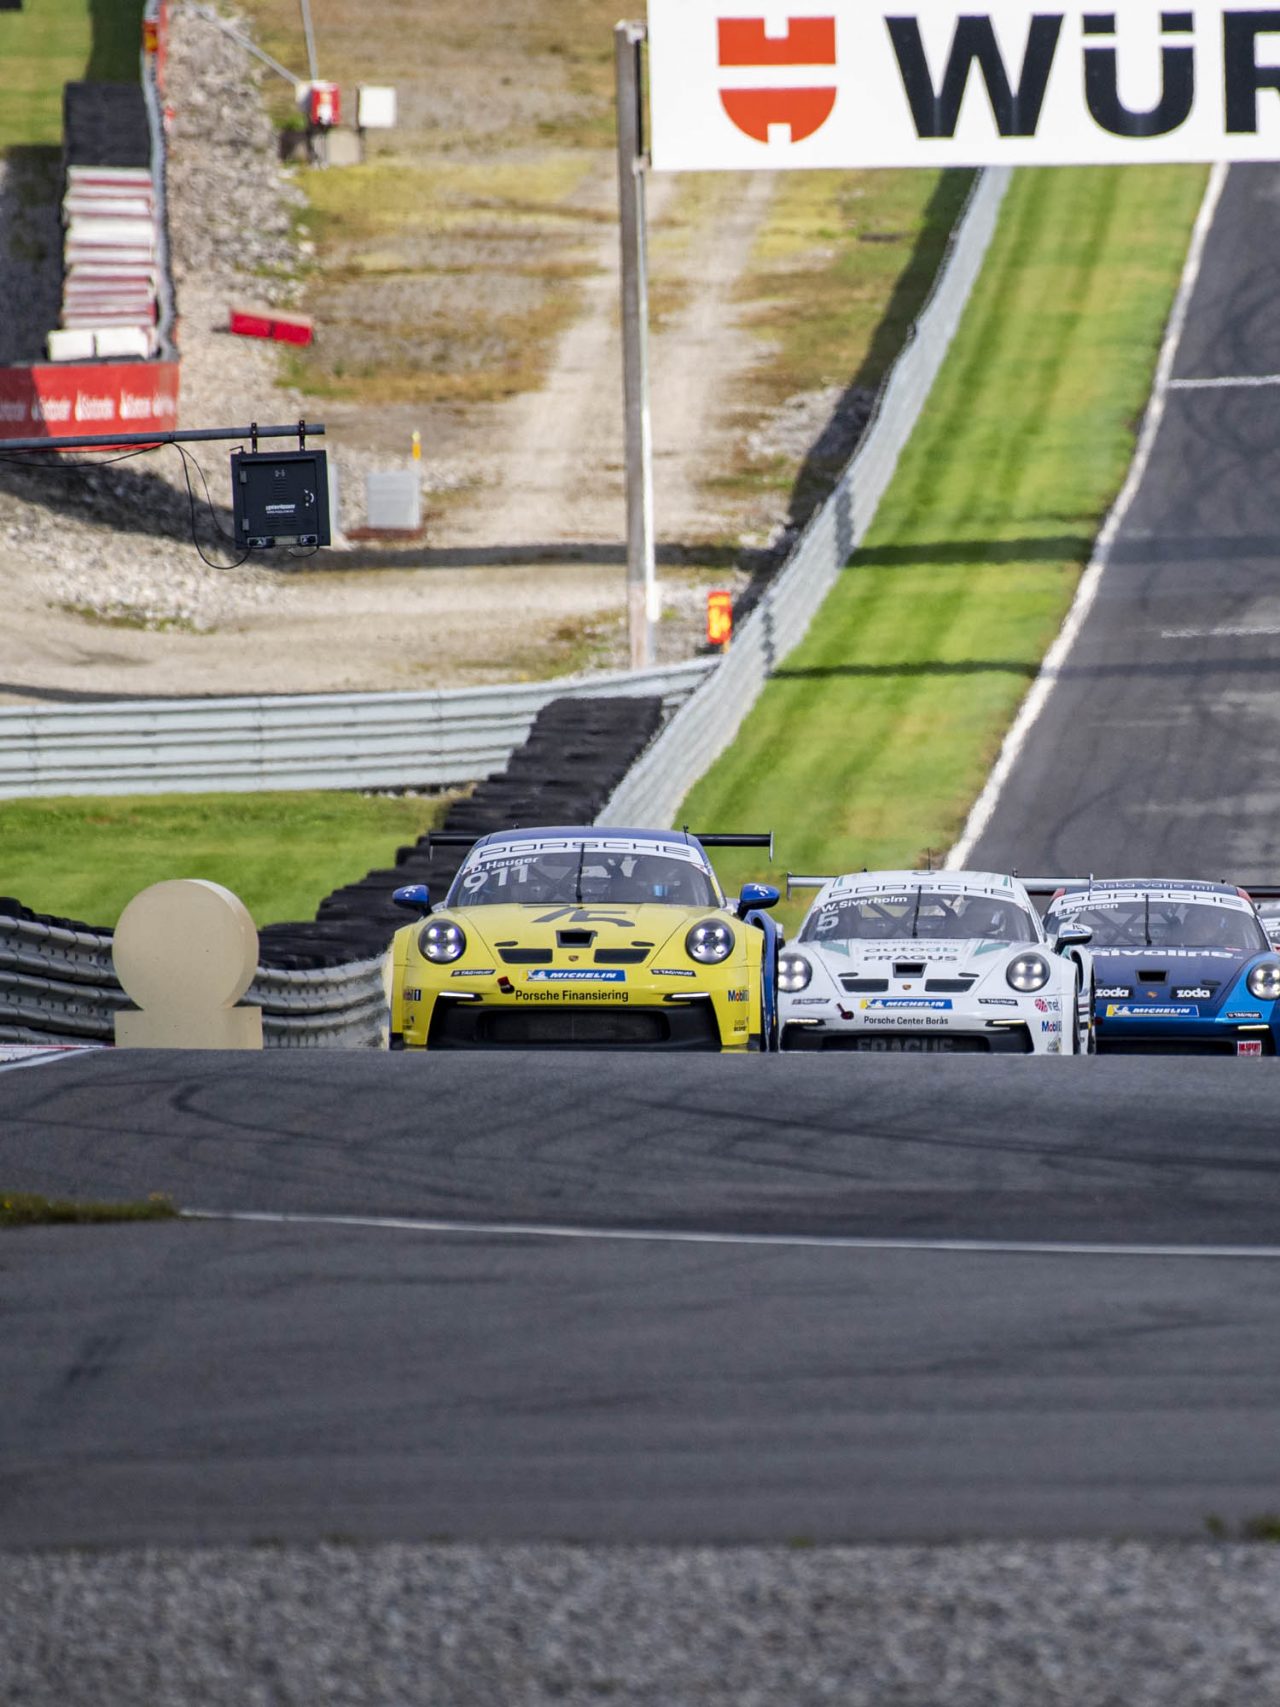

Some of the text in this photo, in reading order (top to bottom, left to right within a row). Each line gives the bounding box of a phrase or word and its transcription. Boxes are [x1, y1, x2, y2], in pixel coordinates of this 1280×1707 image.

[478, 841, 692, 859] PORSCHE
[471, 856, 540, 873] D.Hauger
[463, 864, 529, 894] 911
[828, 883, 1016, 899] PORSCHE
[1061, 891, 1243, 907] PORSCHE
[820, 895, 908, 914] W.Siverholm
[1055, 902, 1119, 918] E.Persson
[816, 909, 841, 933] 5
[549, 971, 618, 980] MICHELIN
[515, 989, 629, 1003] Porsche Finansiering
[1095, 986, 1130, 999] zoda
[1176, 986, 1211, 999] zoda
[885, 1000, 945, 1008] MICHELIN
[1131, 1007, 1191, 1015] MICHELIN
[863, 1014, 949, 1025] Porsche Center Borås
